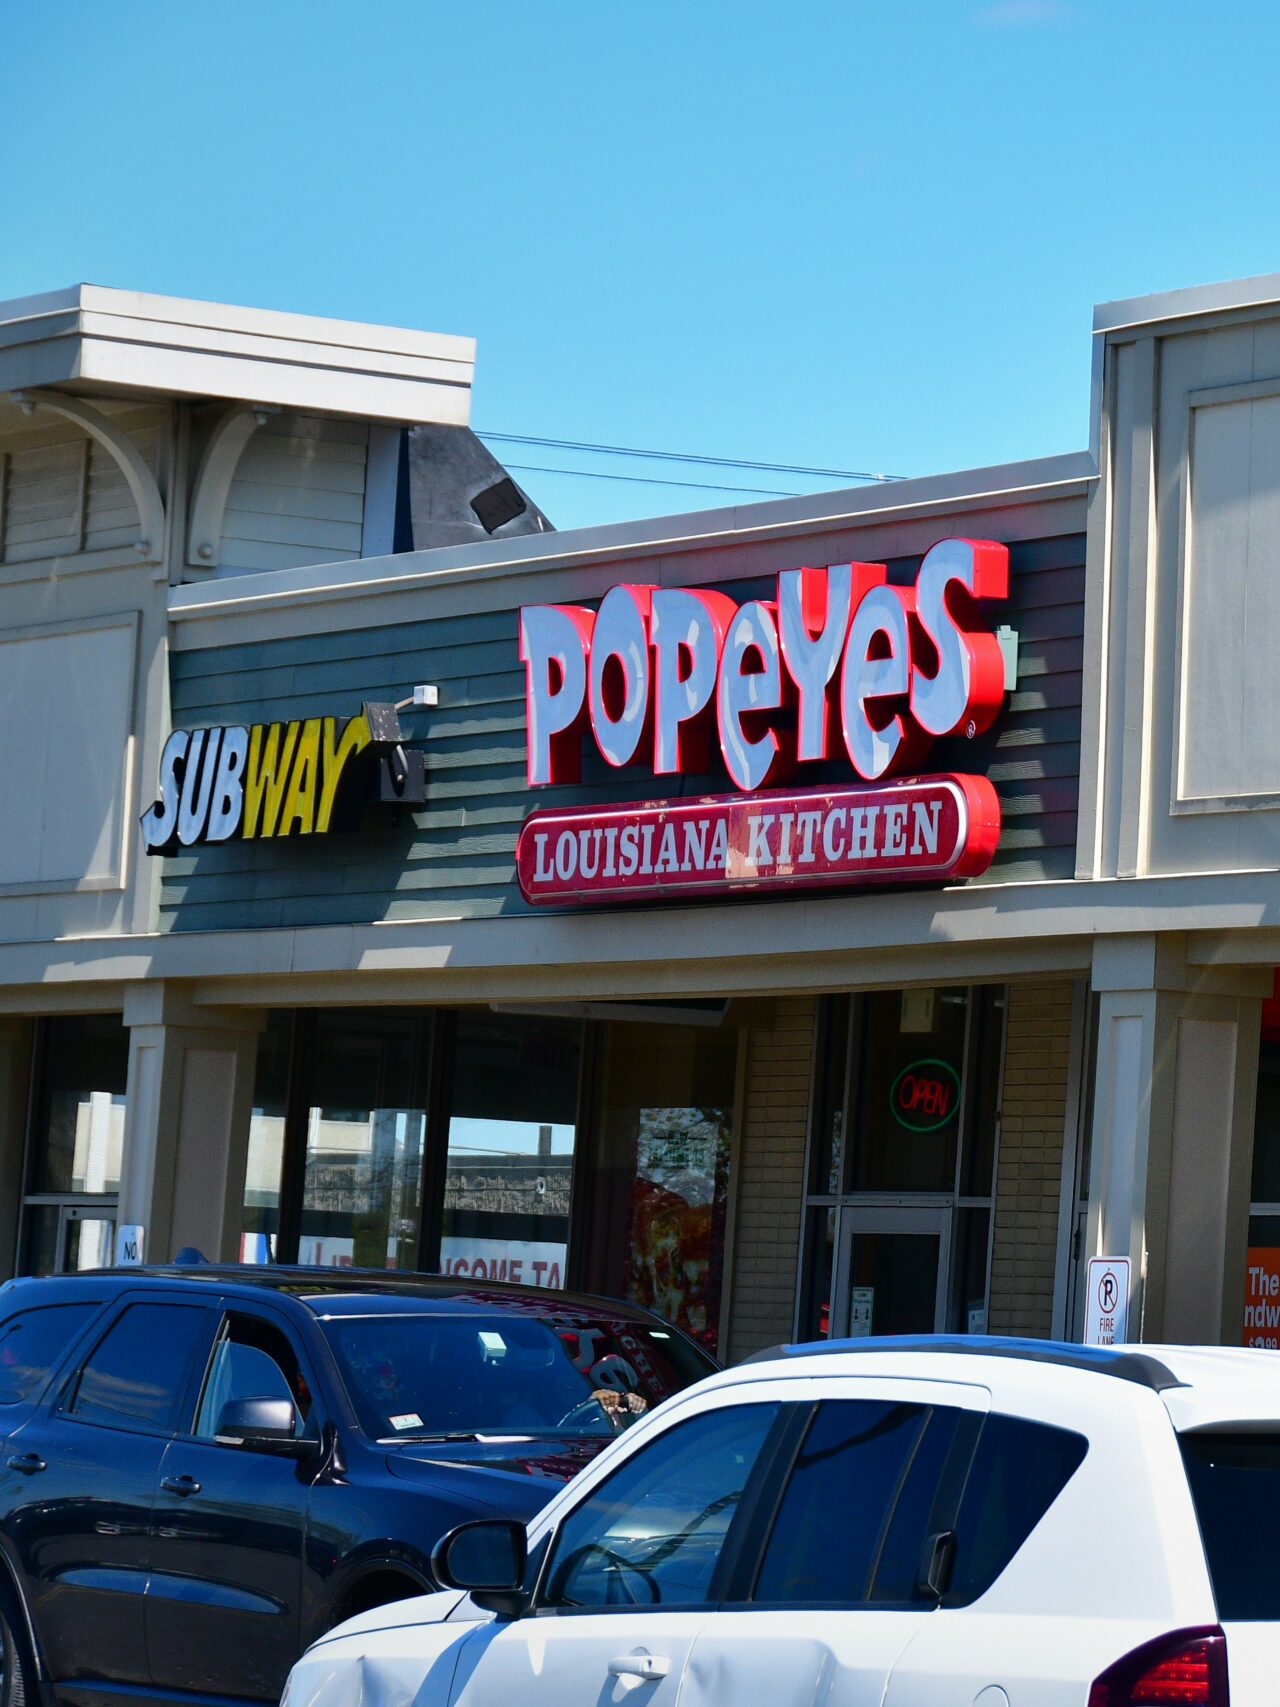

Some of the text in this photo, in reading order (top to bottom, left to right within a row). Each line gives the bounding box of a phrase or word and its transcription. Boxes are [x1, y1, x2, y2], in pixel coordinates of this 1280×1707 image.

[140, 704, 373, 848] SUBWAY
[533, 800, 943, 883] LOUISIANA KITCHEN
[899, 1074, 951, 1117] OPEN
[123, 1241, 137, 1260] NO
[1248, 1266, 1280, 1296] The
[1099, 1317, 1115, 1333] FIRE
